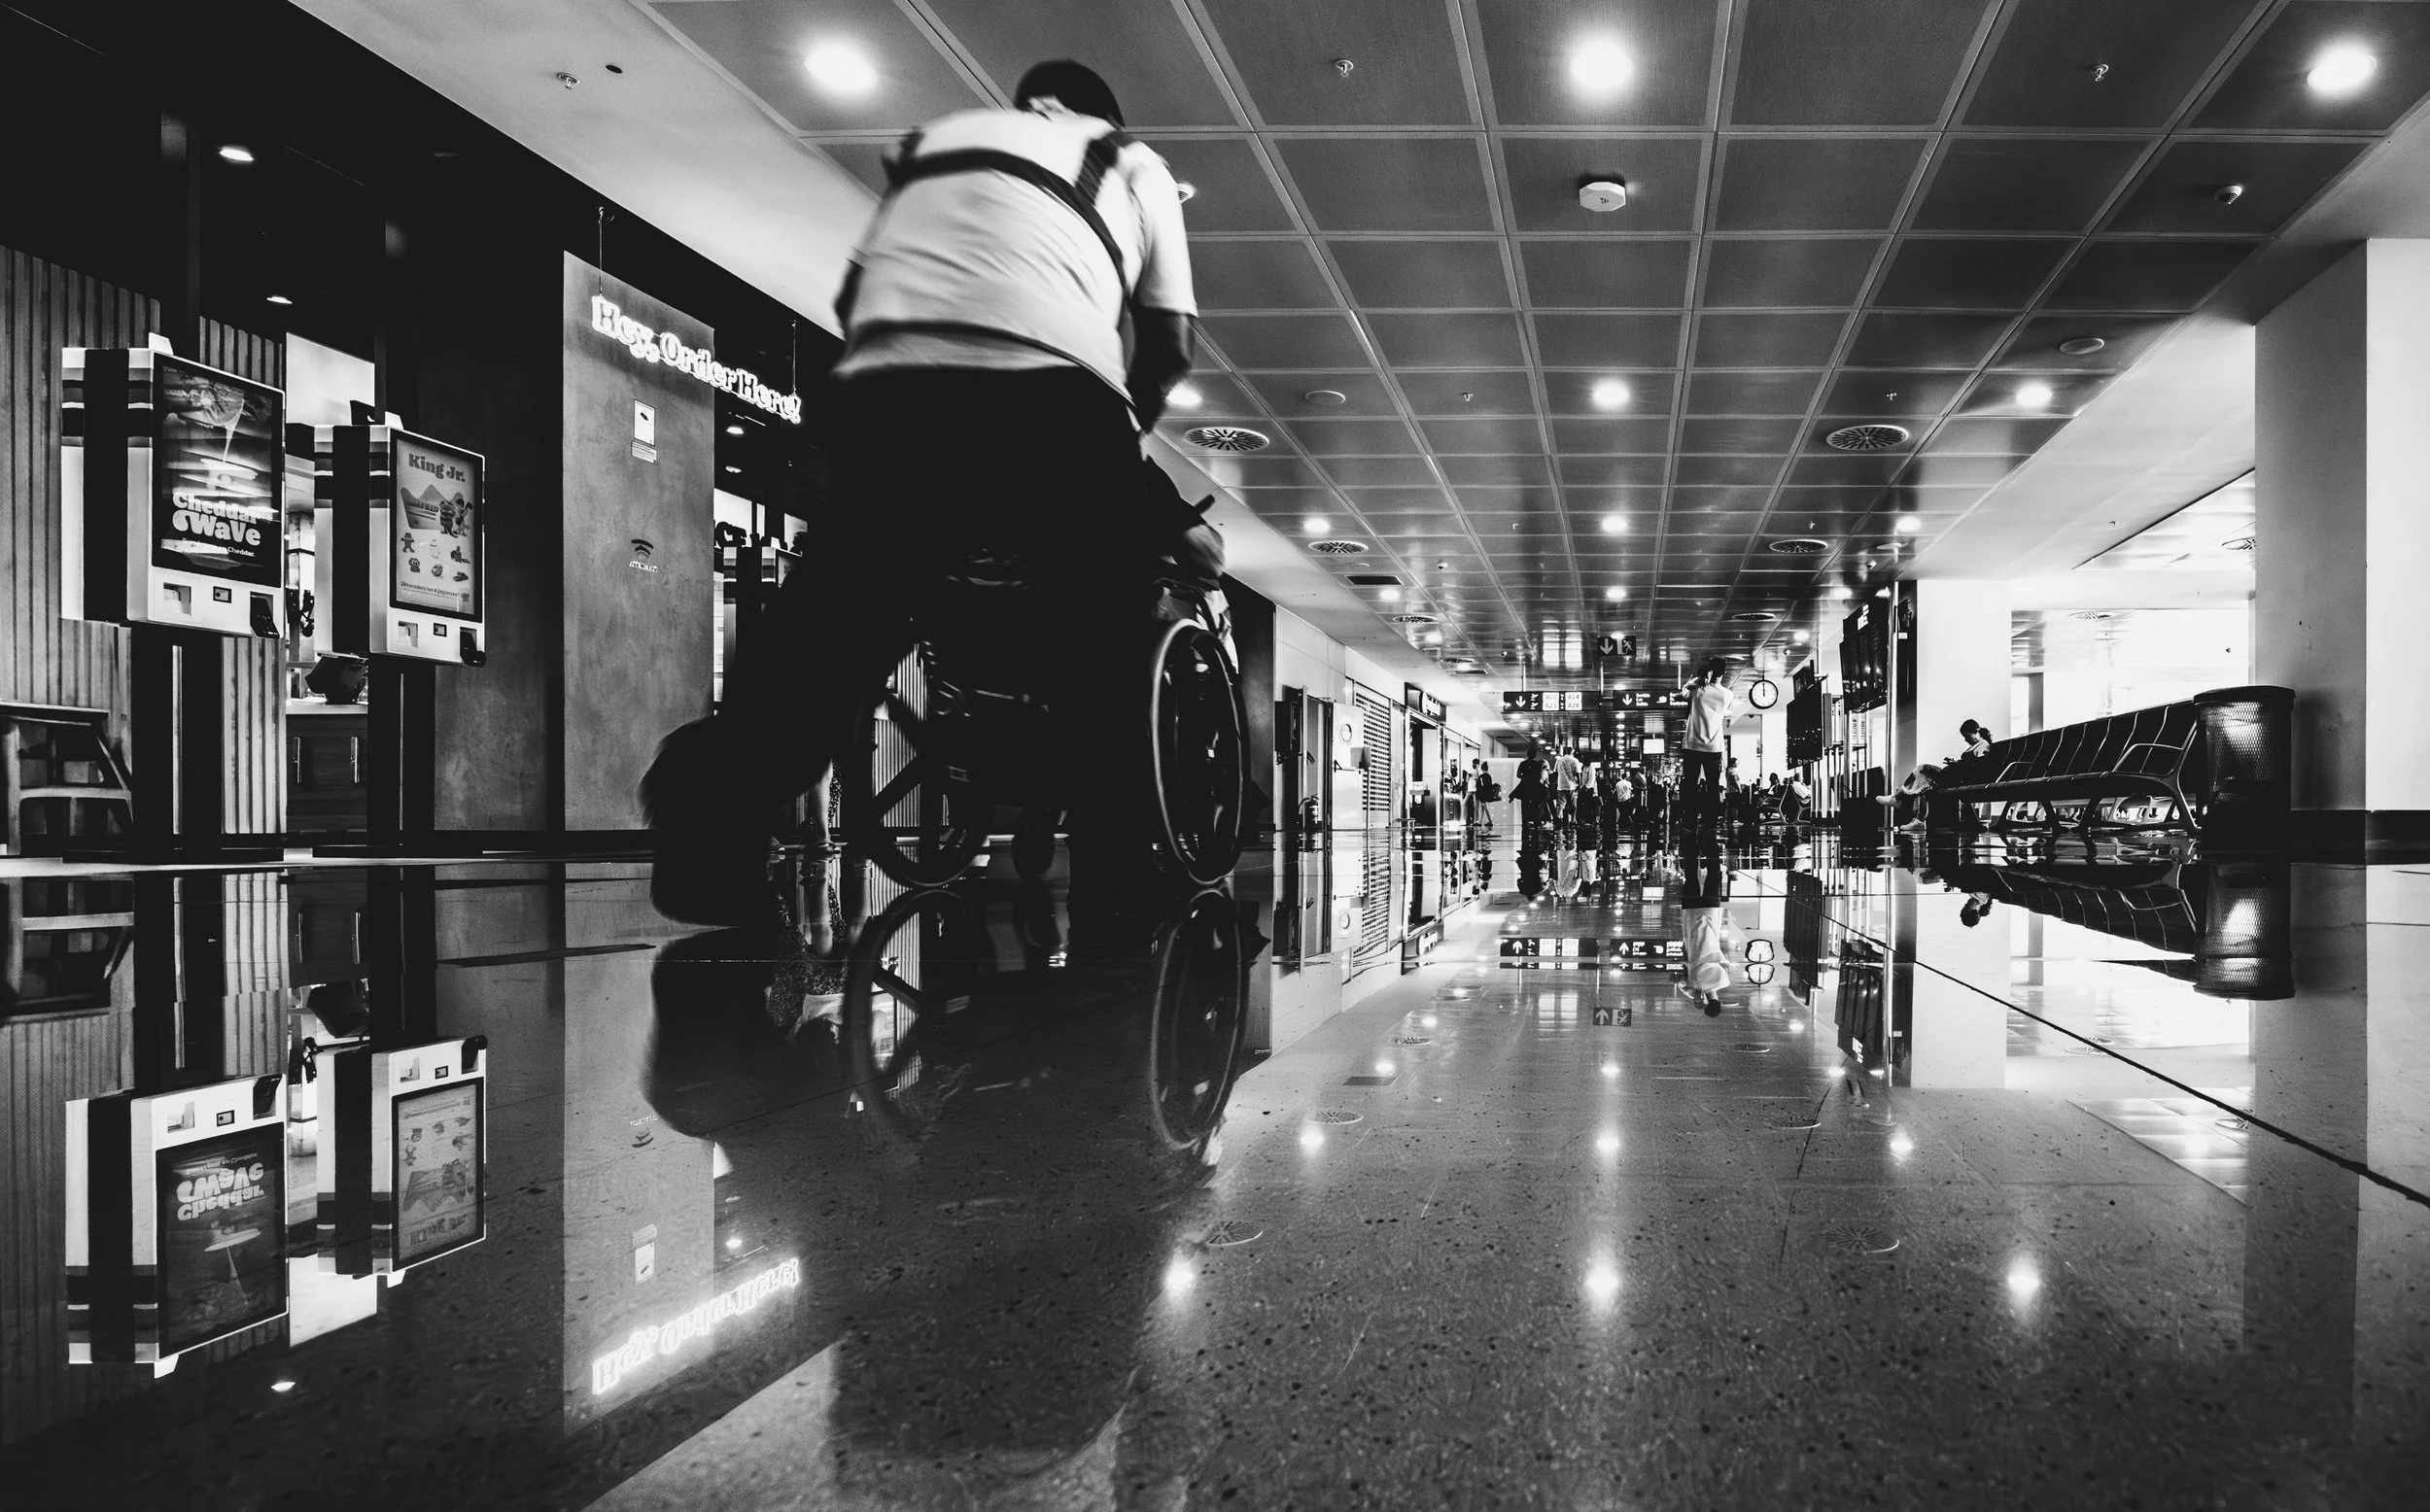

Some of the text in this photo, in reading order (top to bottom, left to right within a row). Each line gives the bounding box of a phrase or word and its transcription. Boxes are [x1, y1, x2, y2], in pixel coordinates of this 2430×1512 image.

[660, 331, 736, 393] Order
[736, 368, 801, 424] Here!
[409, 453, 466, 482] King Jr.
[227, 546, 255, 558] Cheddar
